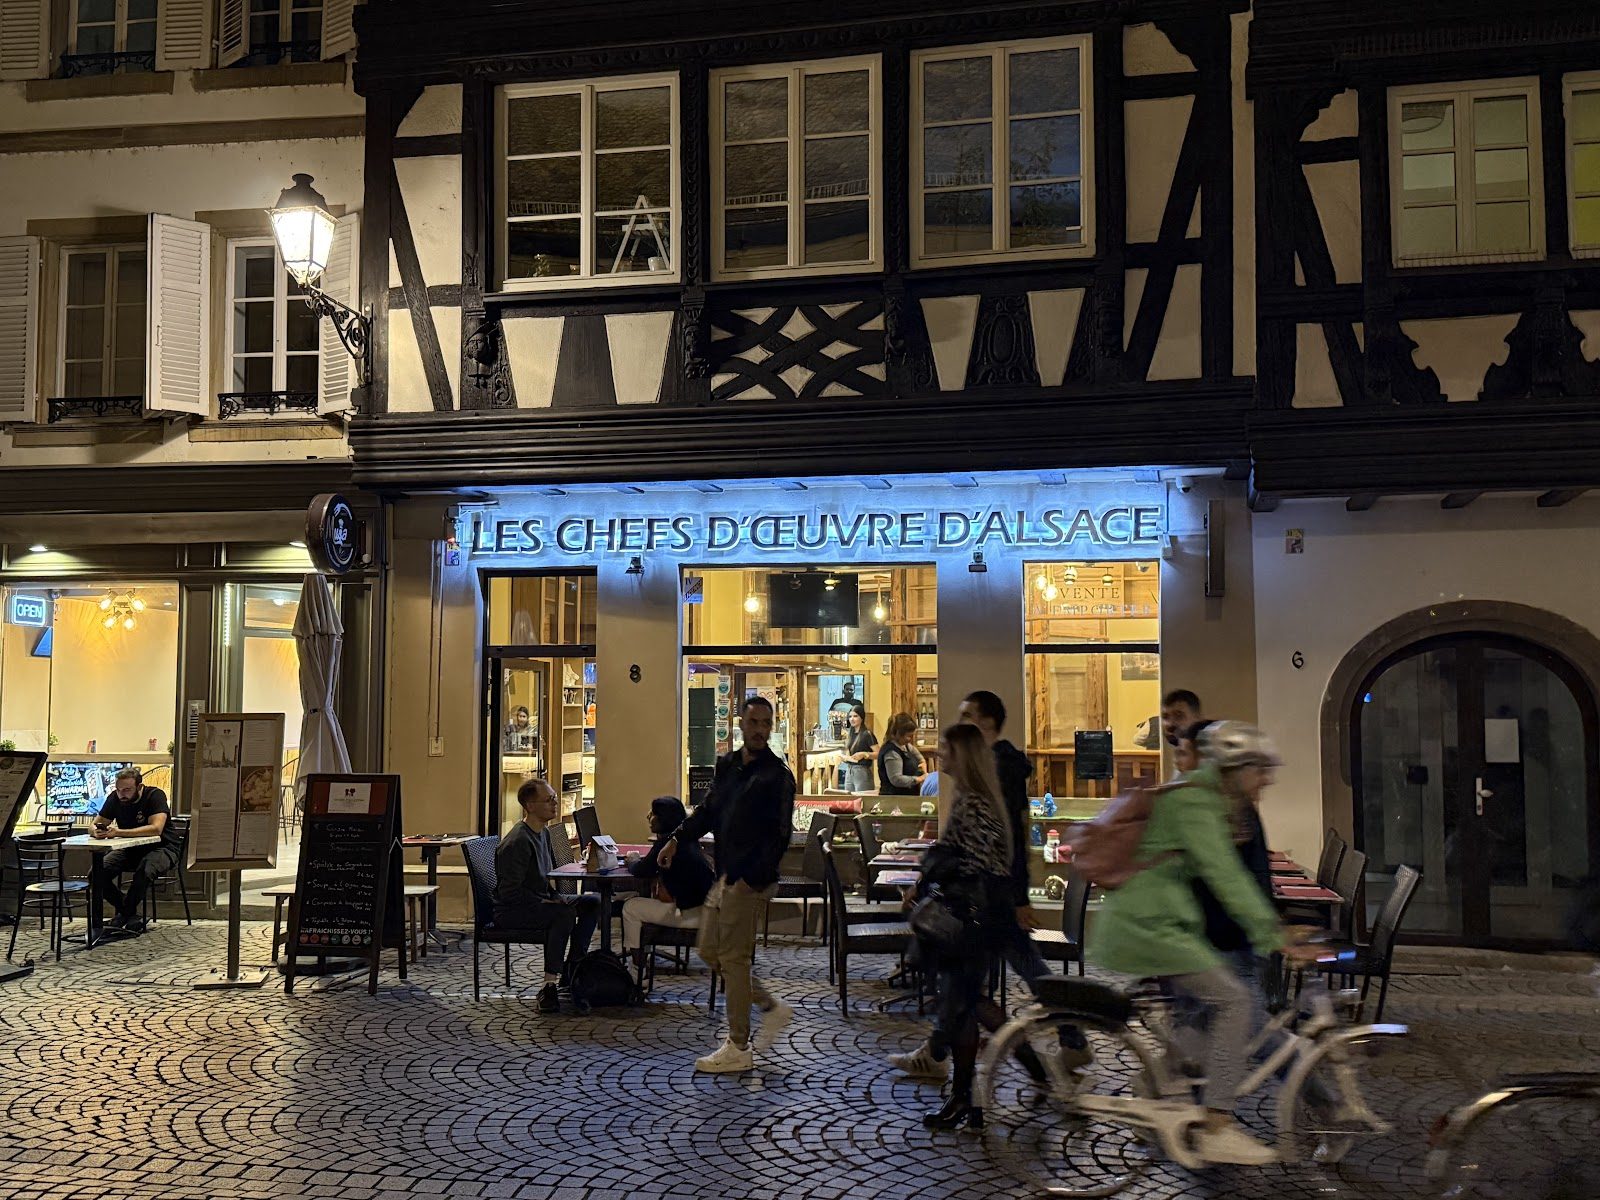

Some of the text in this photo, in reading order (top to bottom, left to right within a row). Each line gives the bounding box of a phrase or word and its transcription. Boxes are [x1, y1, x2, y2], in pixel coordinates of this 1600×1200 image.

[472, 506, 1160, 553] LES CHEFS D'ŒUVRE D'ALSACE
[1060, 587, 1120, 599] VENTE
[17, 603, 43, 618] OPEN
[1292, 651, 1304, 669] 6
[630, 664, 641, 683] 8
